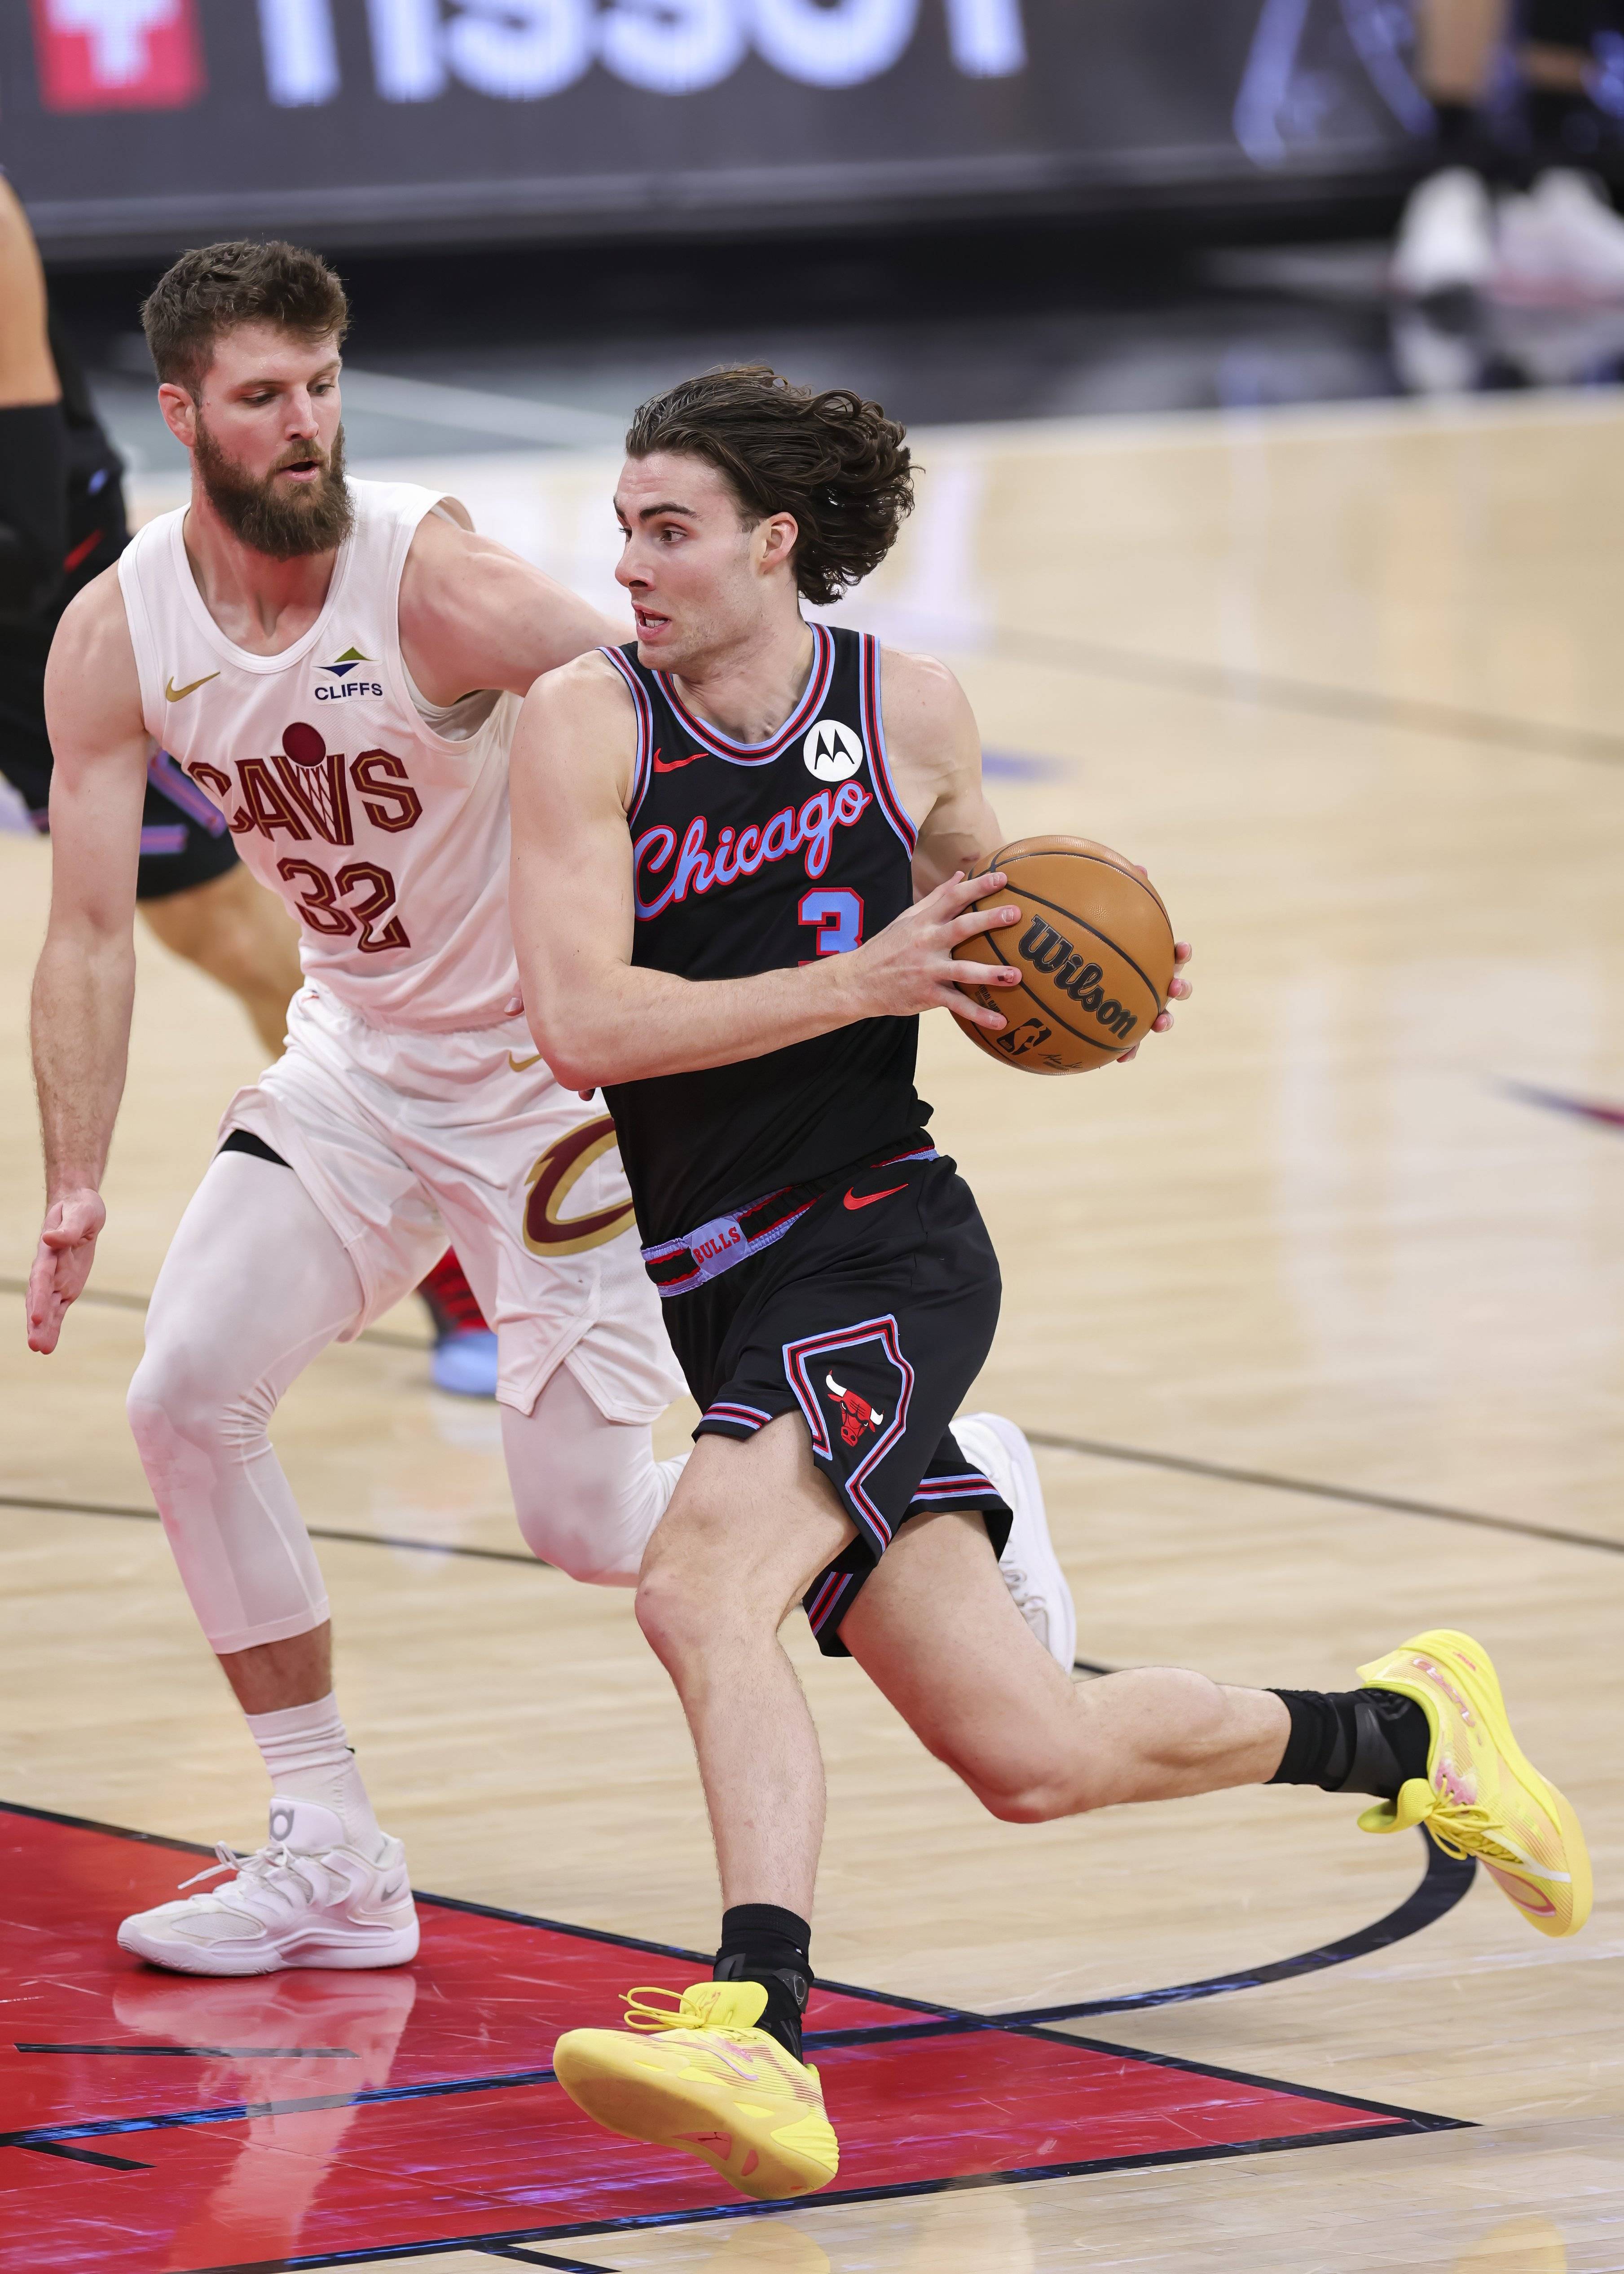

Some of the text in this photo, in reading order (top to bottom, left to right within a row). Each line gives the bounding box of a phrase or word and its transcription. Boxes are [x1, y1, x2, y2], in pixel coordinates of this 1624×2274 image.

[314, 682, 383, 701] CLIFFS
[187, 748, 423, 846] CAVS
[633, 780, 873, 922] Chicago
[276, 857, 411, 953] 32
[798, 887, 865, 967] 3
[1018, 914, 1138, 1040] Wilson
[692, 1226, 741, 1264] BULLS
